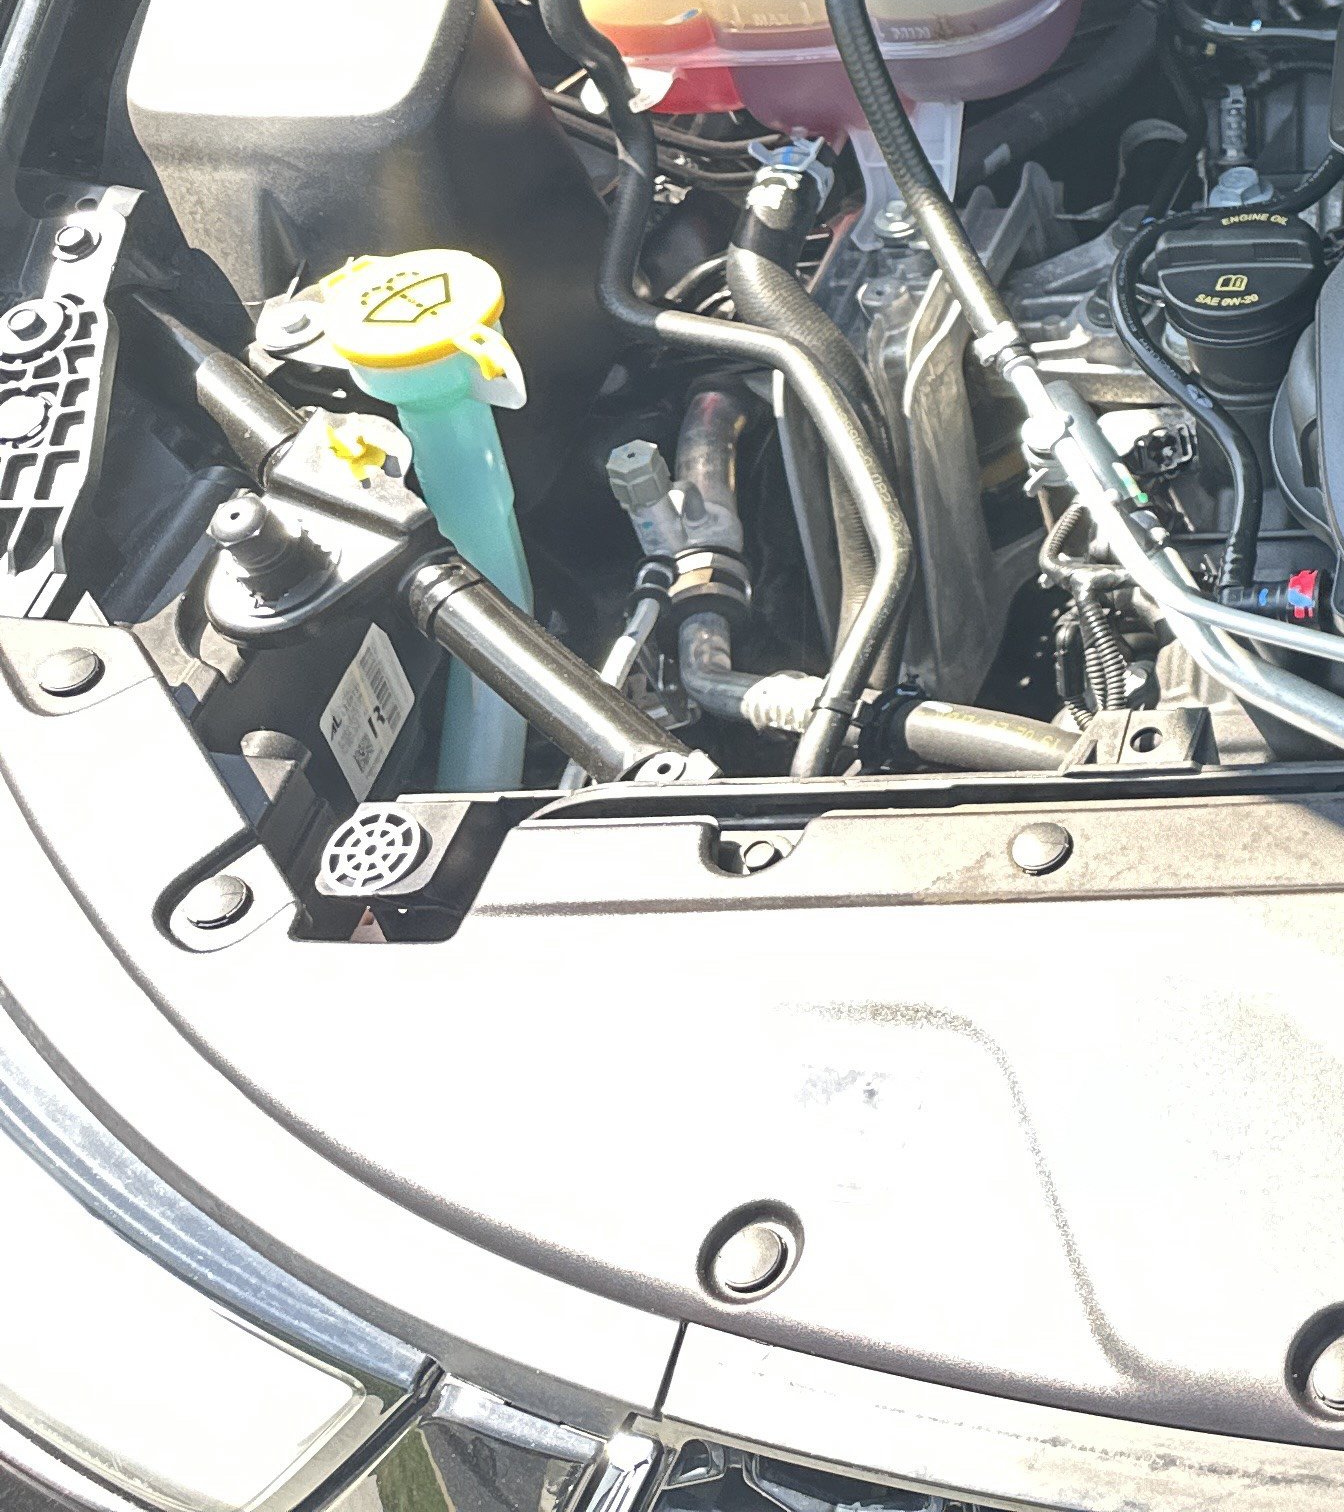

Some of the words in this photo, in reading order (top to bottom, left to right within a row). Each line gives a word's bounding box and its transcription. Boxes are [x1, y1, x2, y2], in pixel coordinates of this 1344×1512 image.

[1221, 213, 1269, 226] ENGINE
[1270, 214, 1289, 226] OIL
[1195, 293, 1220, 306] SAE
[1221, 293, 1259, 306] 0W-20
